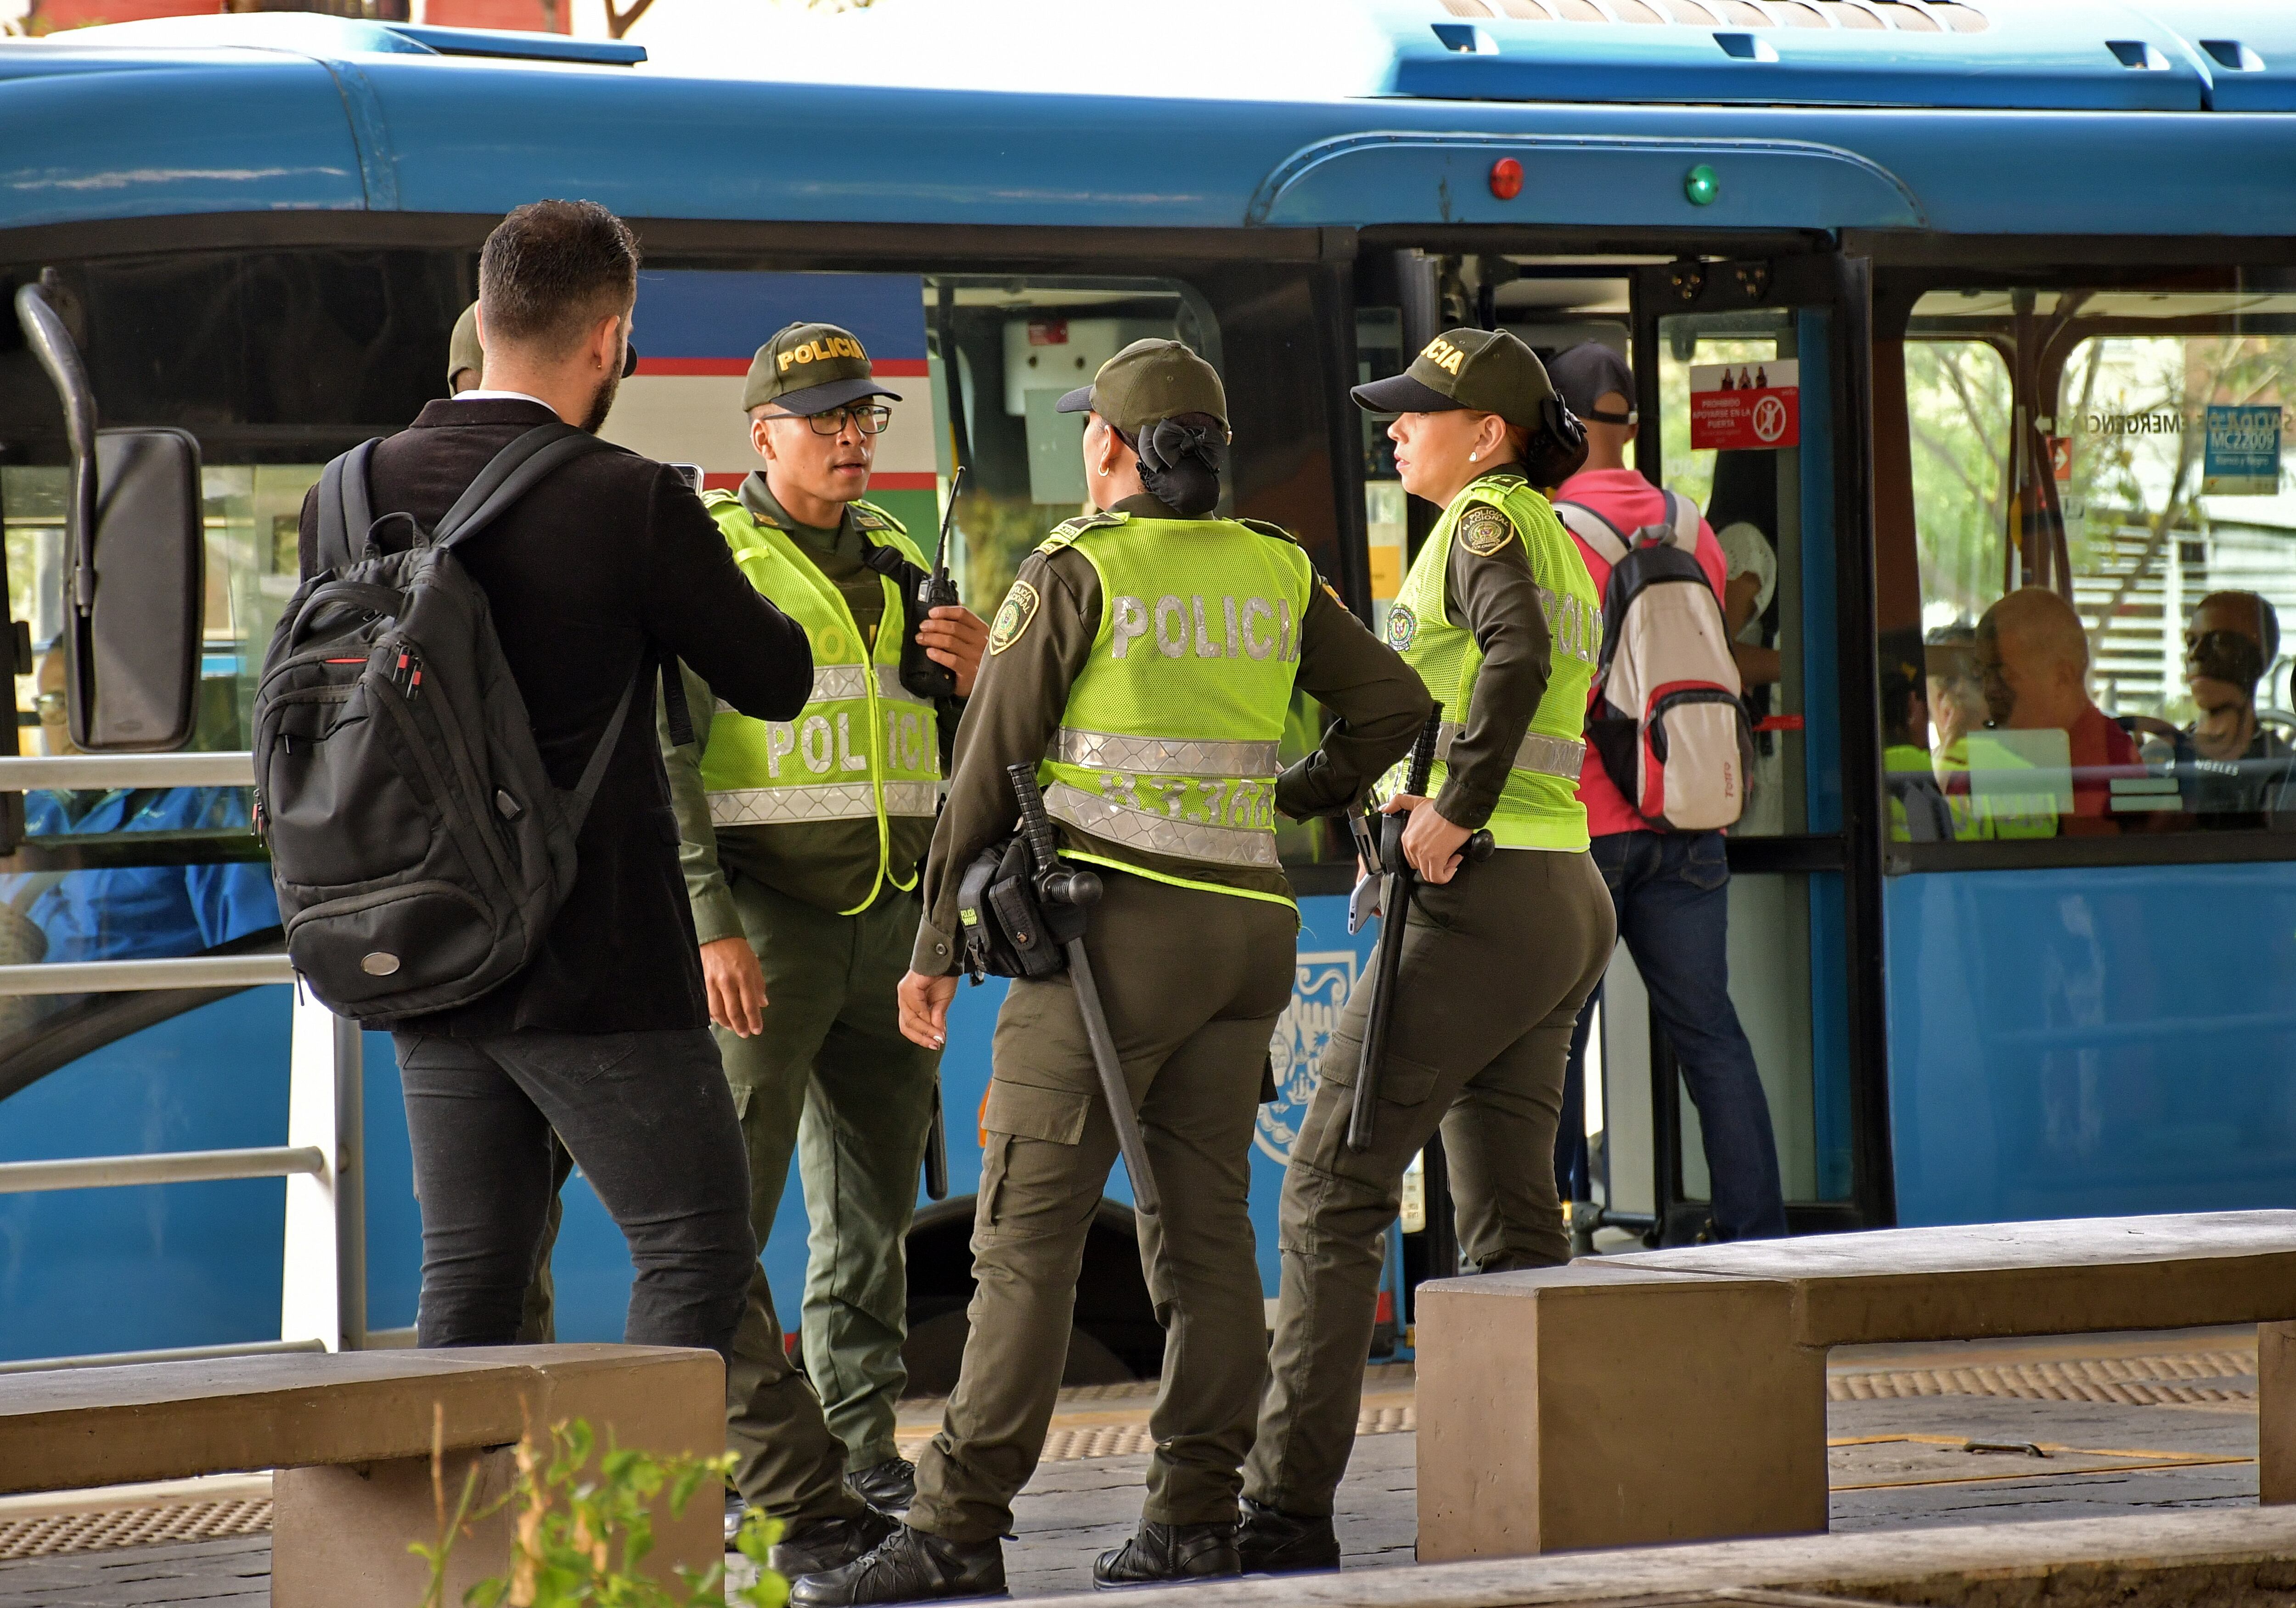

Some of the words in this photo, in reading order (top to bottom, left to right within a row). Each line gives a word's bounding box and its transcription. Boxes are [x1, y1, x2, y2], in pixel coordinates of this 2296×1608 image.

[1421, 337, 1464, 375] ICIA
[1463, 514, 1508, 531] NACIONAL
[766, 710, 940, 779] POLICI
[2195, 759, 2240, 776] NGELES
